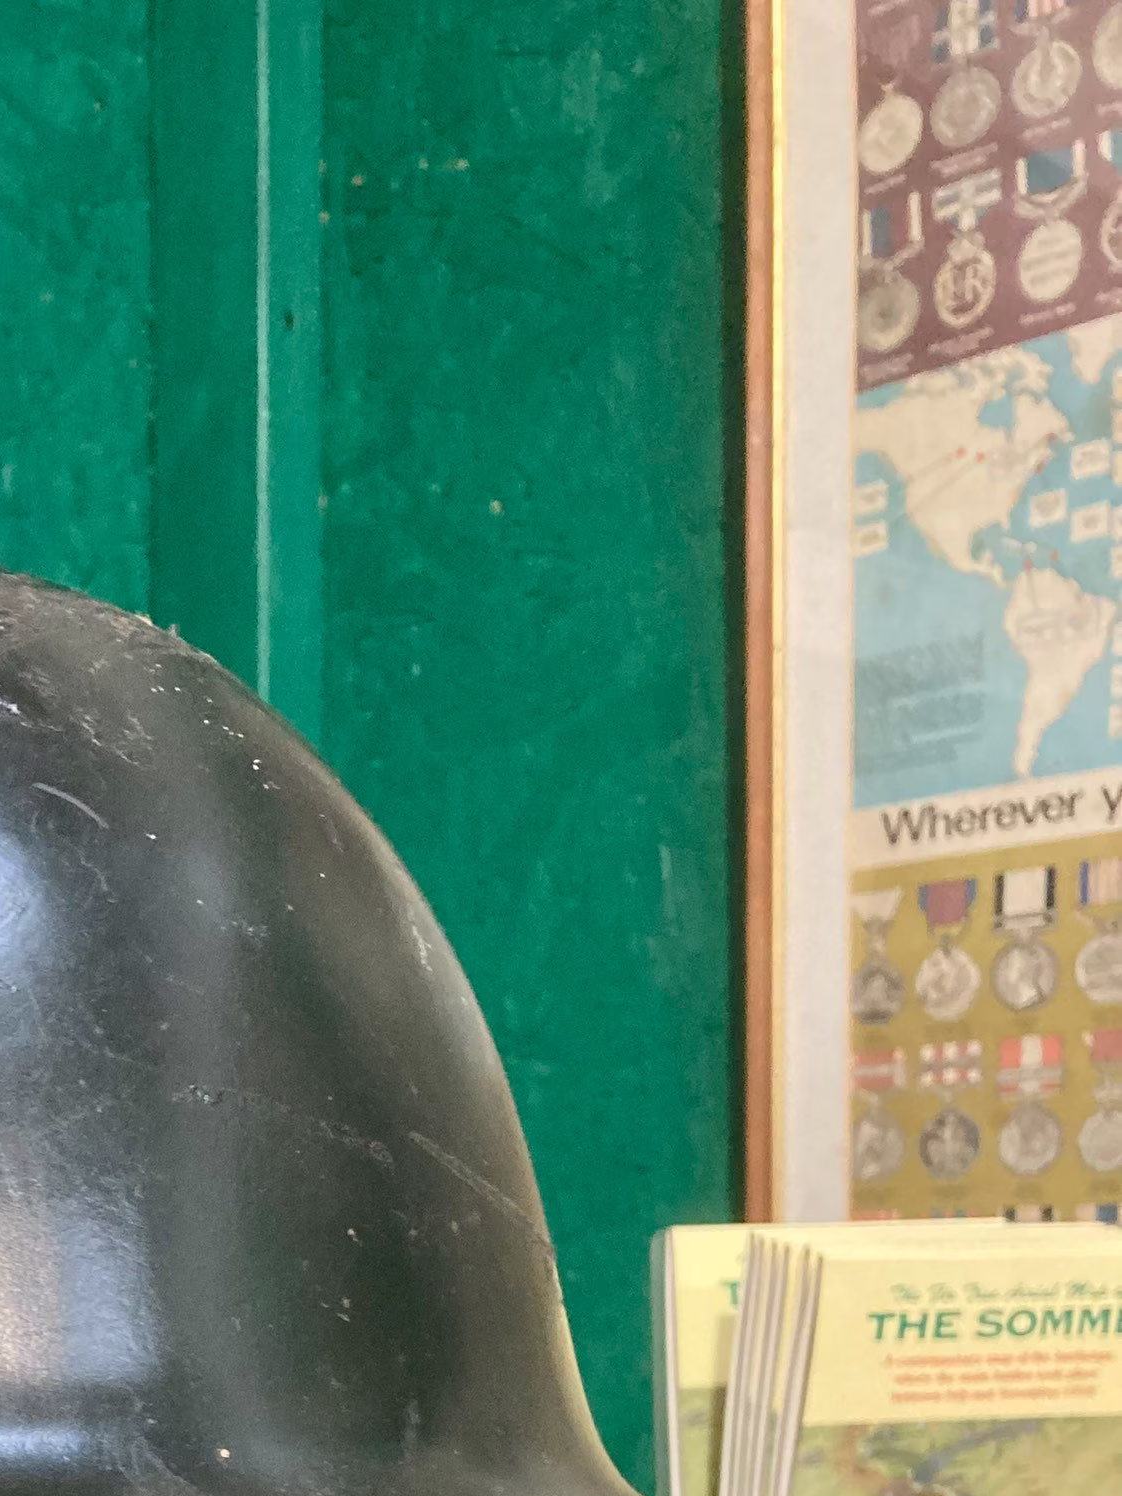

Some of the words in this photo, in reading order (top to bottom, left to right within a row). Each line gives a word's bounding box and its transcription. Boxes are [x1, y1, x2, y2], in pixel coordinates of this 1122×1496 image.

[881, 791, 1083, 845] Wherever
[868, 1309, 961, 1340] THE
[977, 1306, 1122, 1338] SOMM
